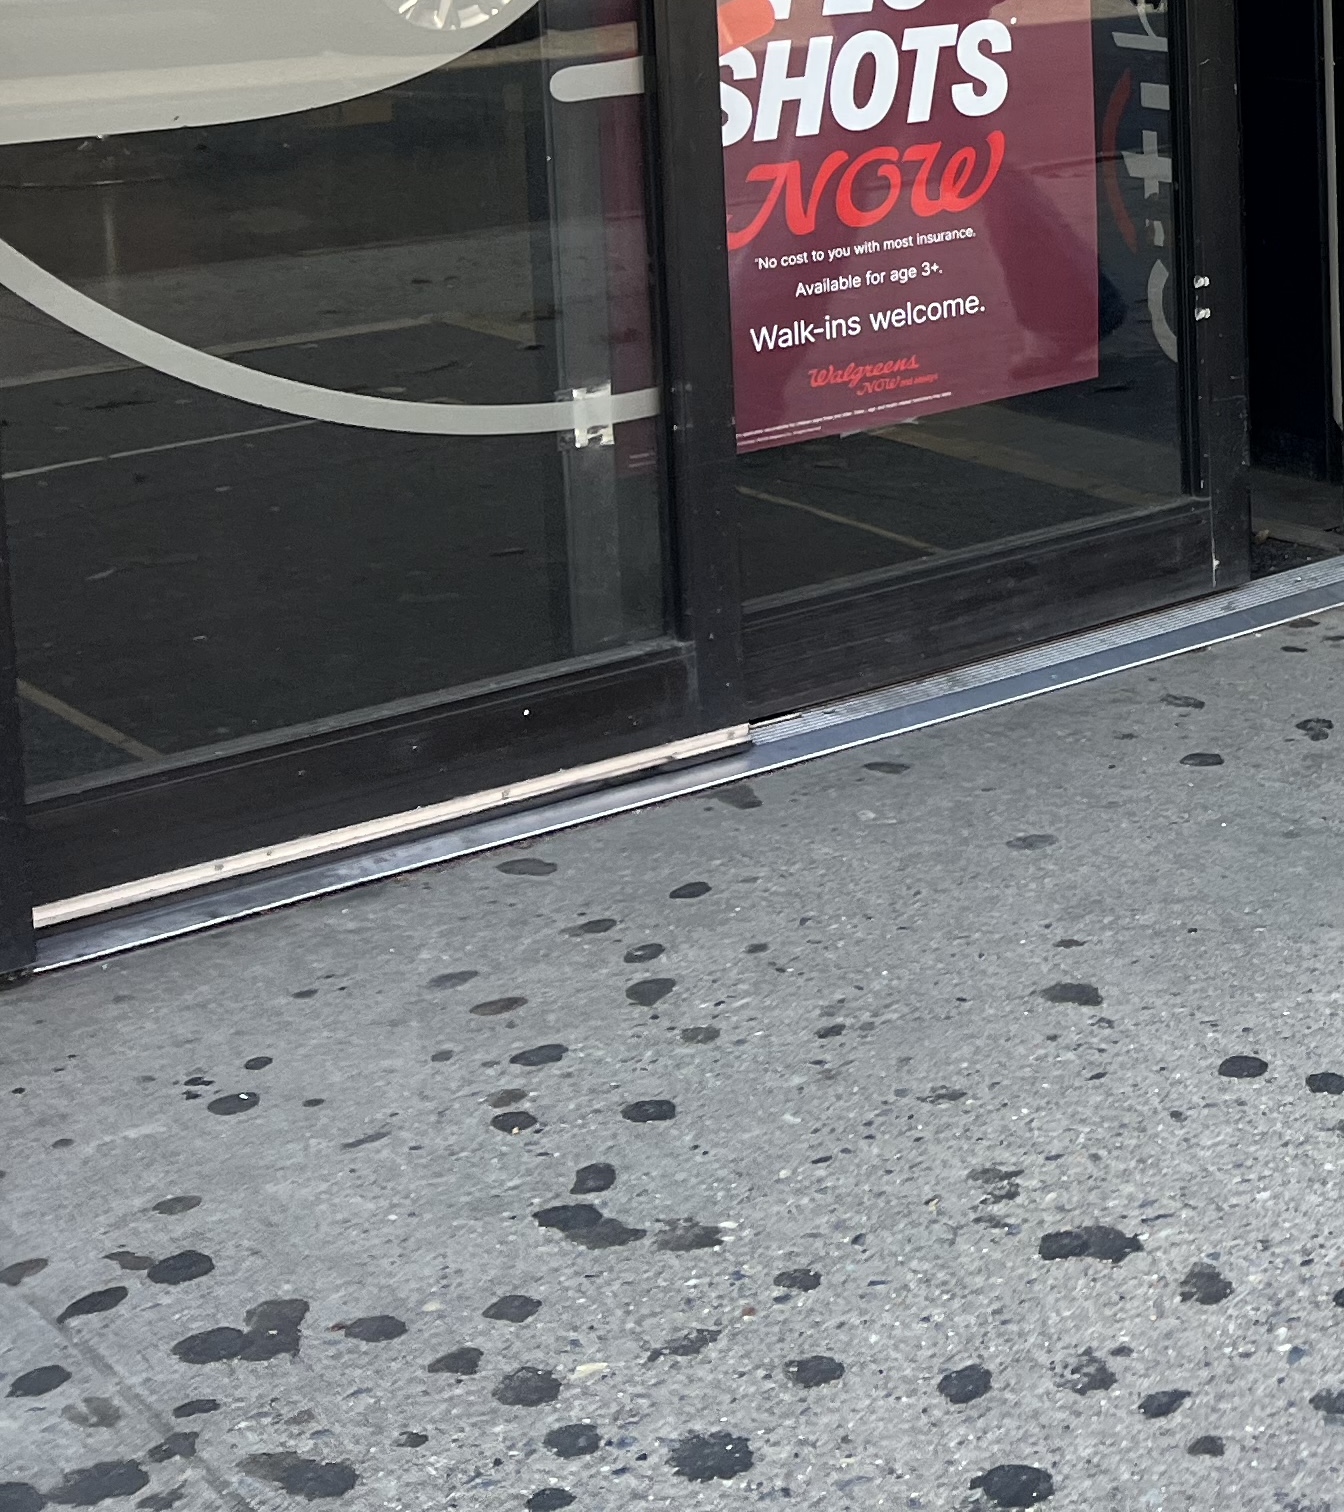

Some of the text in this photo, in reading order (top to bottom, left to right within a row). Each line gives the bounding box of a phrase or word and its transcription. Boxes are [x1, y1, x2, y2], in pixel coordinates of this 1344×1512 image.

[719, 18, 1013, 148] SHOTS
[726, 129, 1006, 251] NOW
[780, 250, 809, 267] cost
[811, 249, 825, 263] to
[828, 244, 851, 261] you
[853, 240, 881, 255] with
[883, 235, 914, 251] most
[916, 227, 976, 246] insurance.
[795, 261, 944, 298] Available for age 3+.
[750, 294, 986, 353] Walk-ins welcome.
[808, 354, 920, 388] Walgreens
